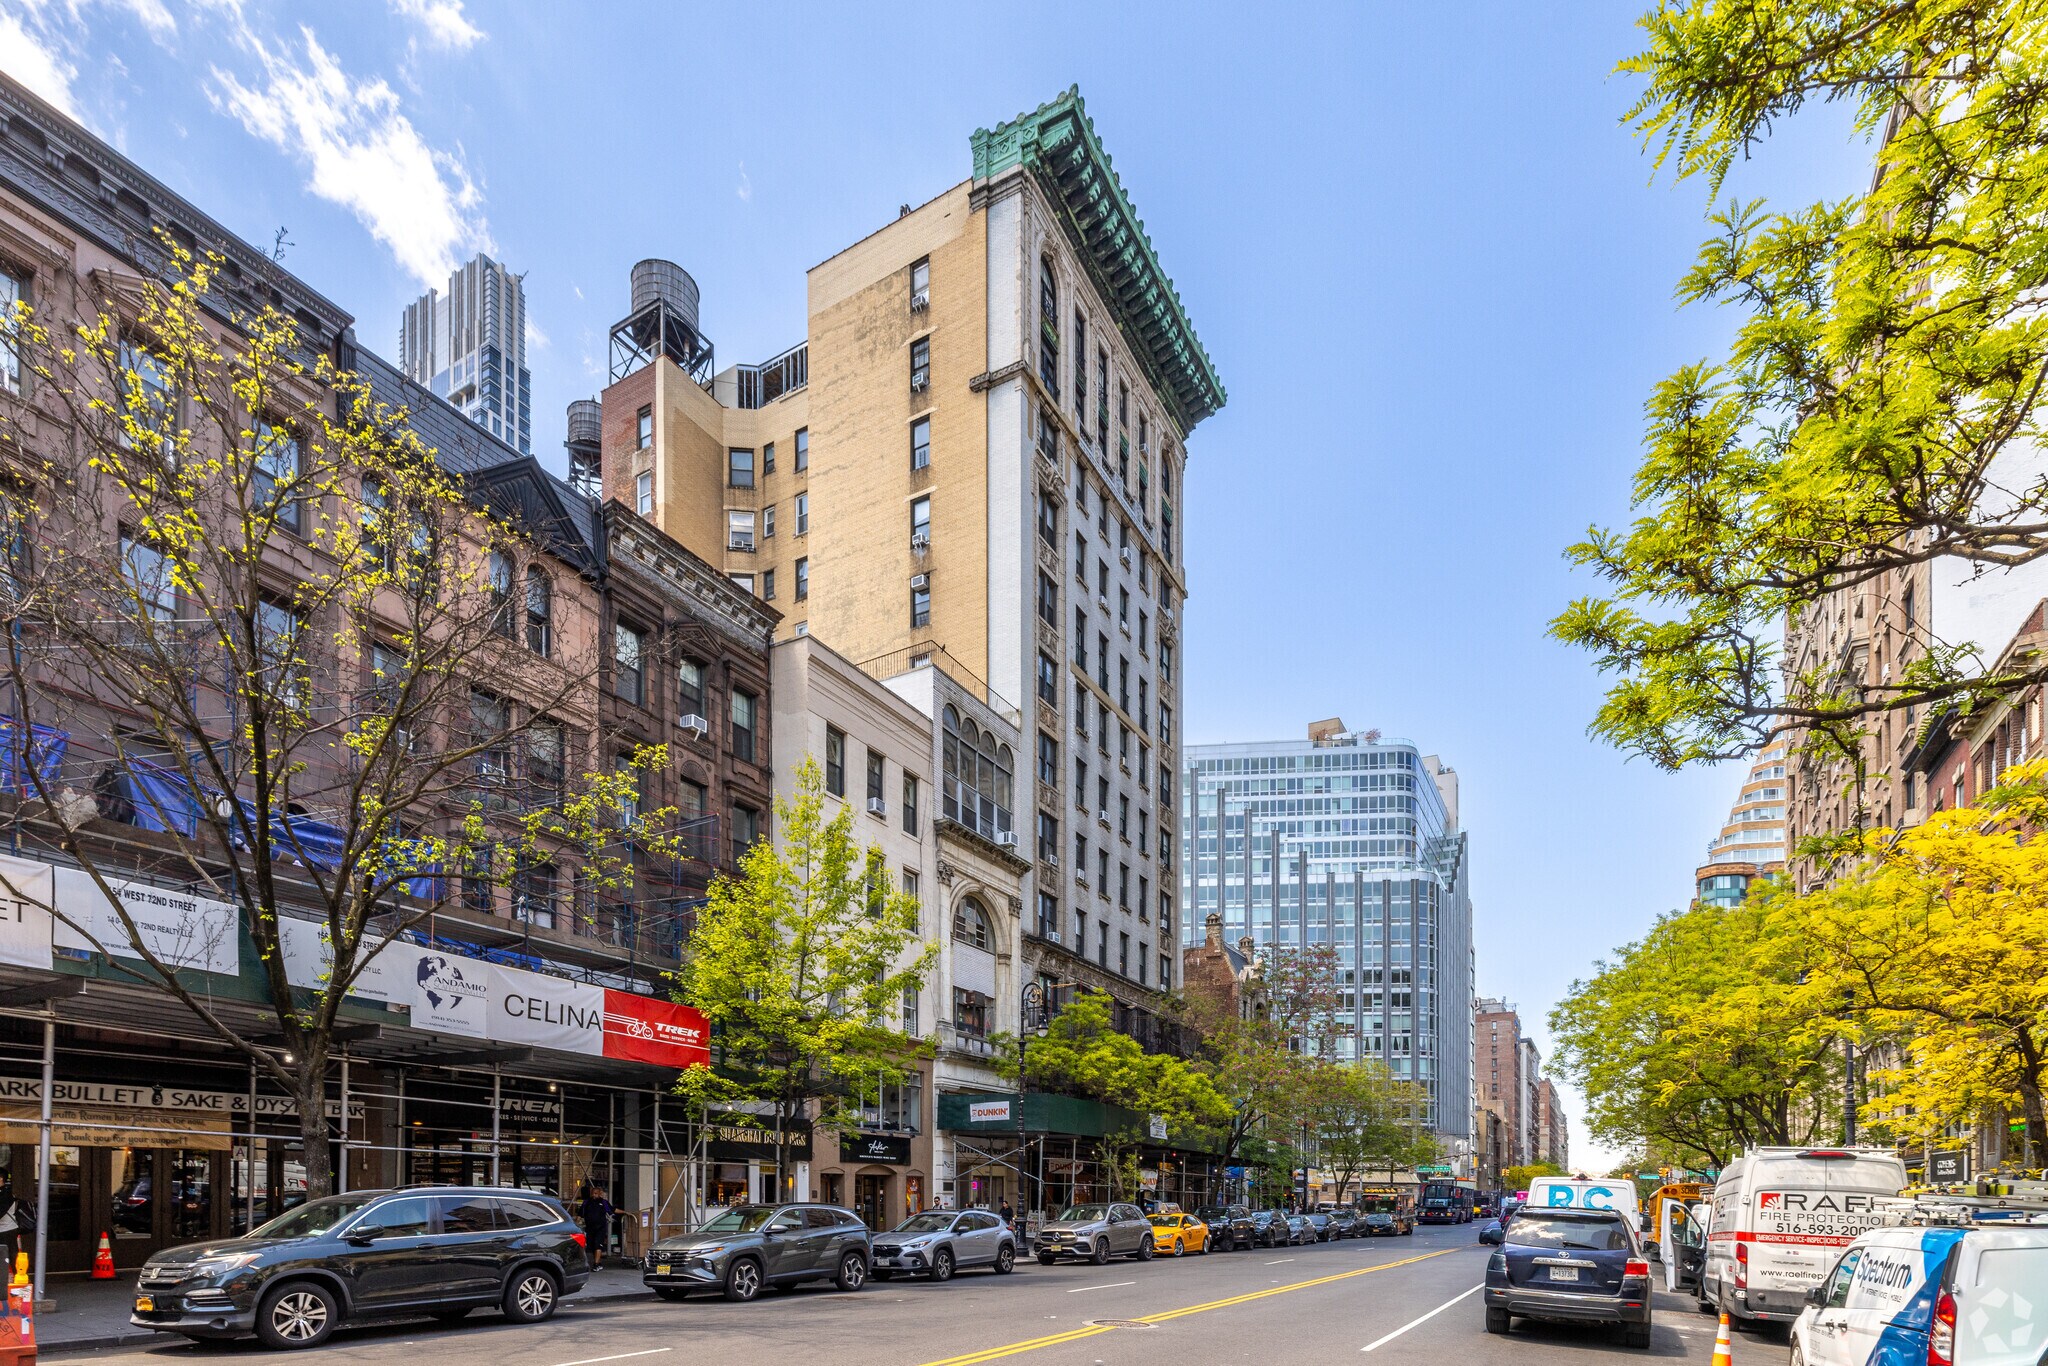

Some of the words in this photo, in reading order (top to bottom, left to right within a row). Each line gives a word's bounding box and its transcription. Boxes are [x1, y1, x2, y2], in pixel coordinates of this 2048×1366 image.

[123, 889, 145, 902] WEST
[147, 894, 168, 907] 72ND
[168, 899, 197, 912] STREET
[140, 921, 157, 932] 72ND
[157, 926, 181, 937] REALTY
[434, 977, 487, 993] ANDAMIO
[503, 993, 603, 1033] CELINA
[654, 1022, 701, 1039] TREK
[52, 1084, 144, 1104] BULLET
[171, 1092, 223, 1109] SAKE
[231, 1096, 246, 1110] &
[484, 1096, 560, 1114] TREK
[62, 1131, 92, 1142] Thank
[93, 1135, 111, 1144] you
[112, 1133, 126, 1142] for
[128, 1136, 150, 1145] your
[235, 1147, 245, 1157] A
[1760, 1211, 1791, 1222] FIRE
[1797, 1213, 1886, 1227] PROTECTIO
[1756, 1233, 1785, 1243] EMERGENCY
[1857, 1252, 1911, 1289] Spectrum
